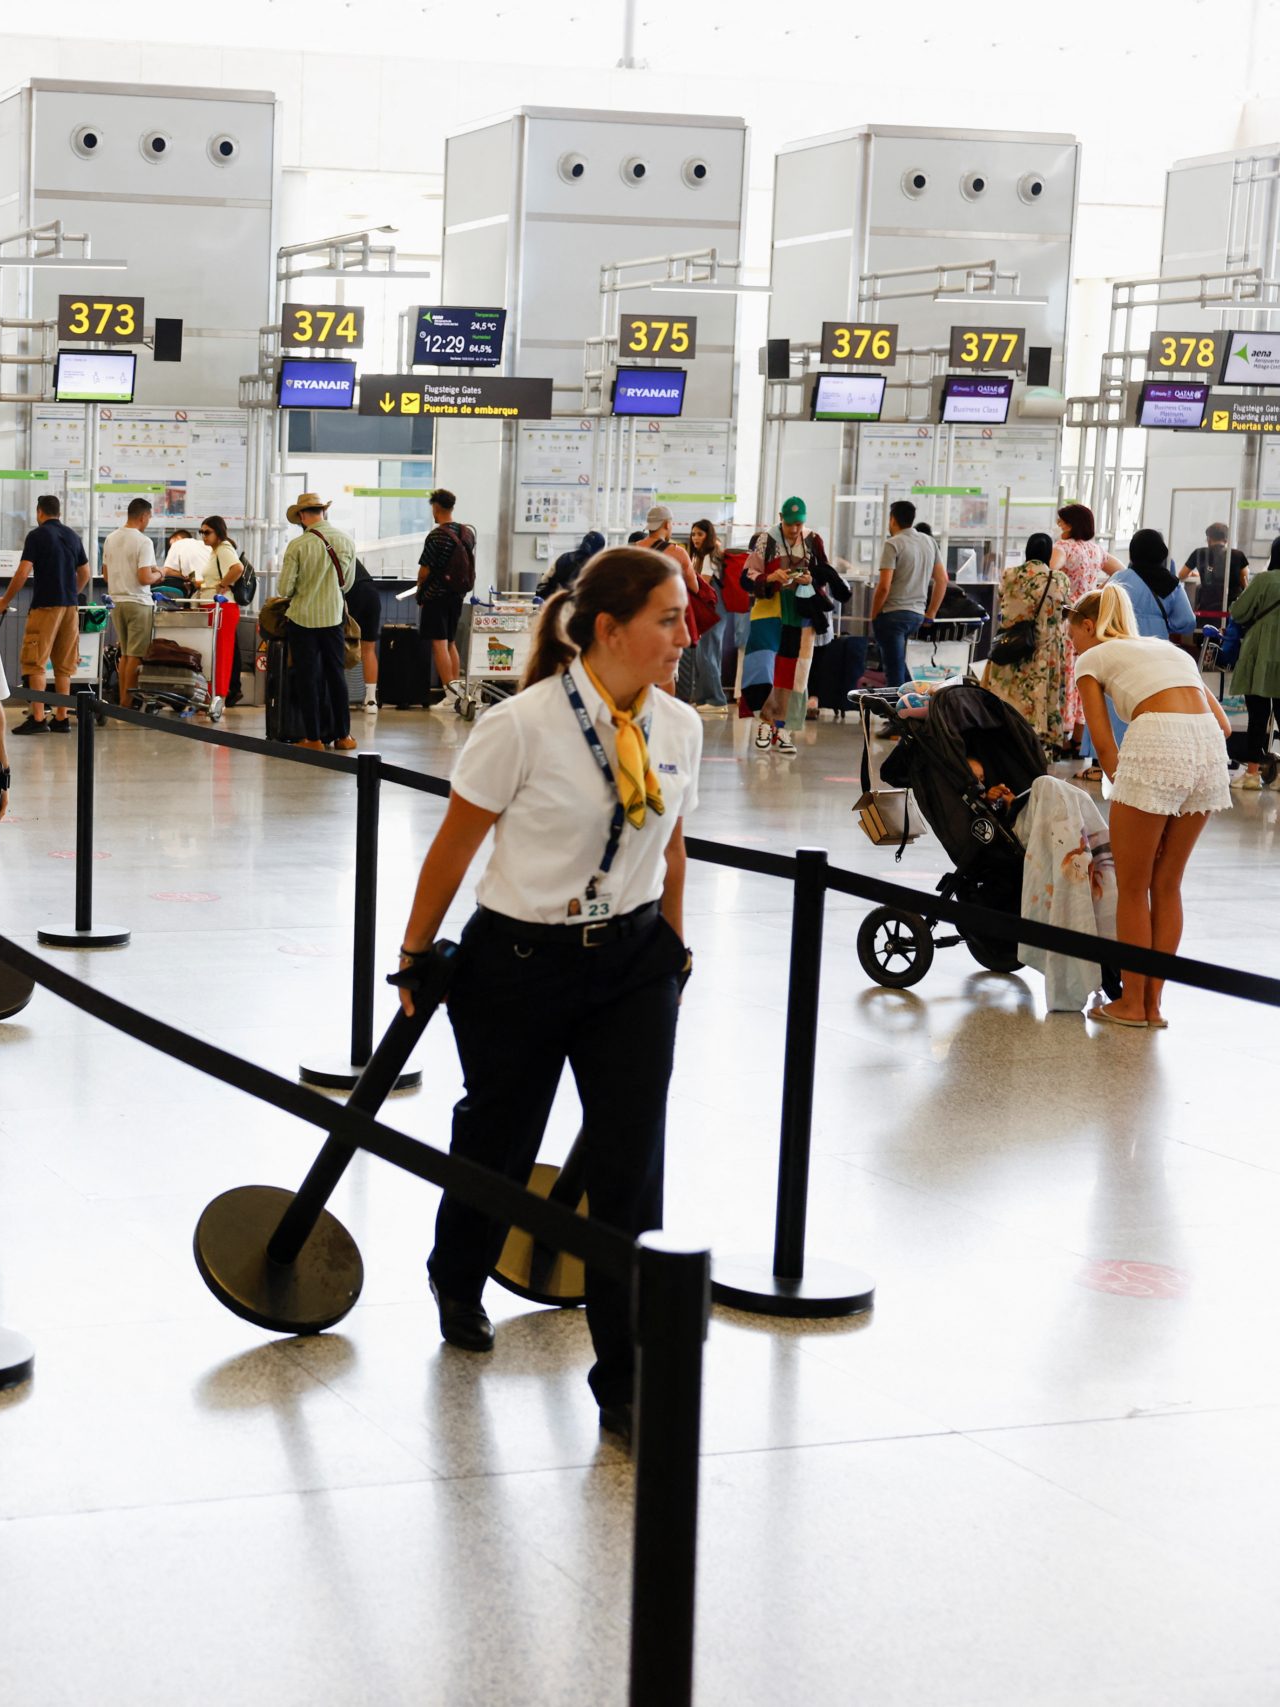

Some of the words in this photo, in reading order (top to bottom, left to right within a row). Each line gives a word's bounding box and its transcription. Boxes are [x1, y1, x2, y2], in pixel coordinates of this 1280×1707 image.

[68, 302, 135, 336] 373
[292, 310, 358, 343] 374
[628, 320, 689, 353] 375
[424, 335, 465, 353] 12:29
[468, 344, 492, 353] 64,5%
[832, 328, 891, 360] 376
[960, 332, 1019, 363] 377
[1159, 337, 1215, 367] 378
[1251, 350, 1272, 358] aena
[293, 379, 351, 390] RYANAIR
[424, 385, 460, 395] Flugsteige
[461, 386, 482, 395] Gates
[626, 387, 679, 398] RYANAIR
[1174, 390, 1194, 398] QATAR
[424, 394, 455, 404] Boarding
[456, 396, 477, 404] gates
[423, 404, 458, 414] Puertas
[460, 405, 472, 414] de
[474, 406, 519, 417] embarque
[1233, 403, 1264, 413] Flugsteige
[1265, 404, 1280, 413] Gate
[1232, 412, 1259, 422] Boarding
[1260, 414, 1278, 422] gates
[1231, 421, 1261, 431] Puertas
[1263, 422, 1274, 431] de
[588, 902, 610, 917] 23
